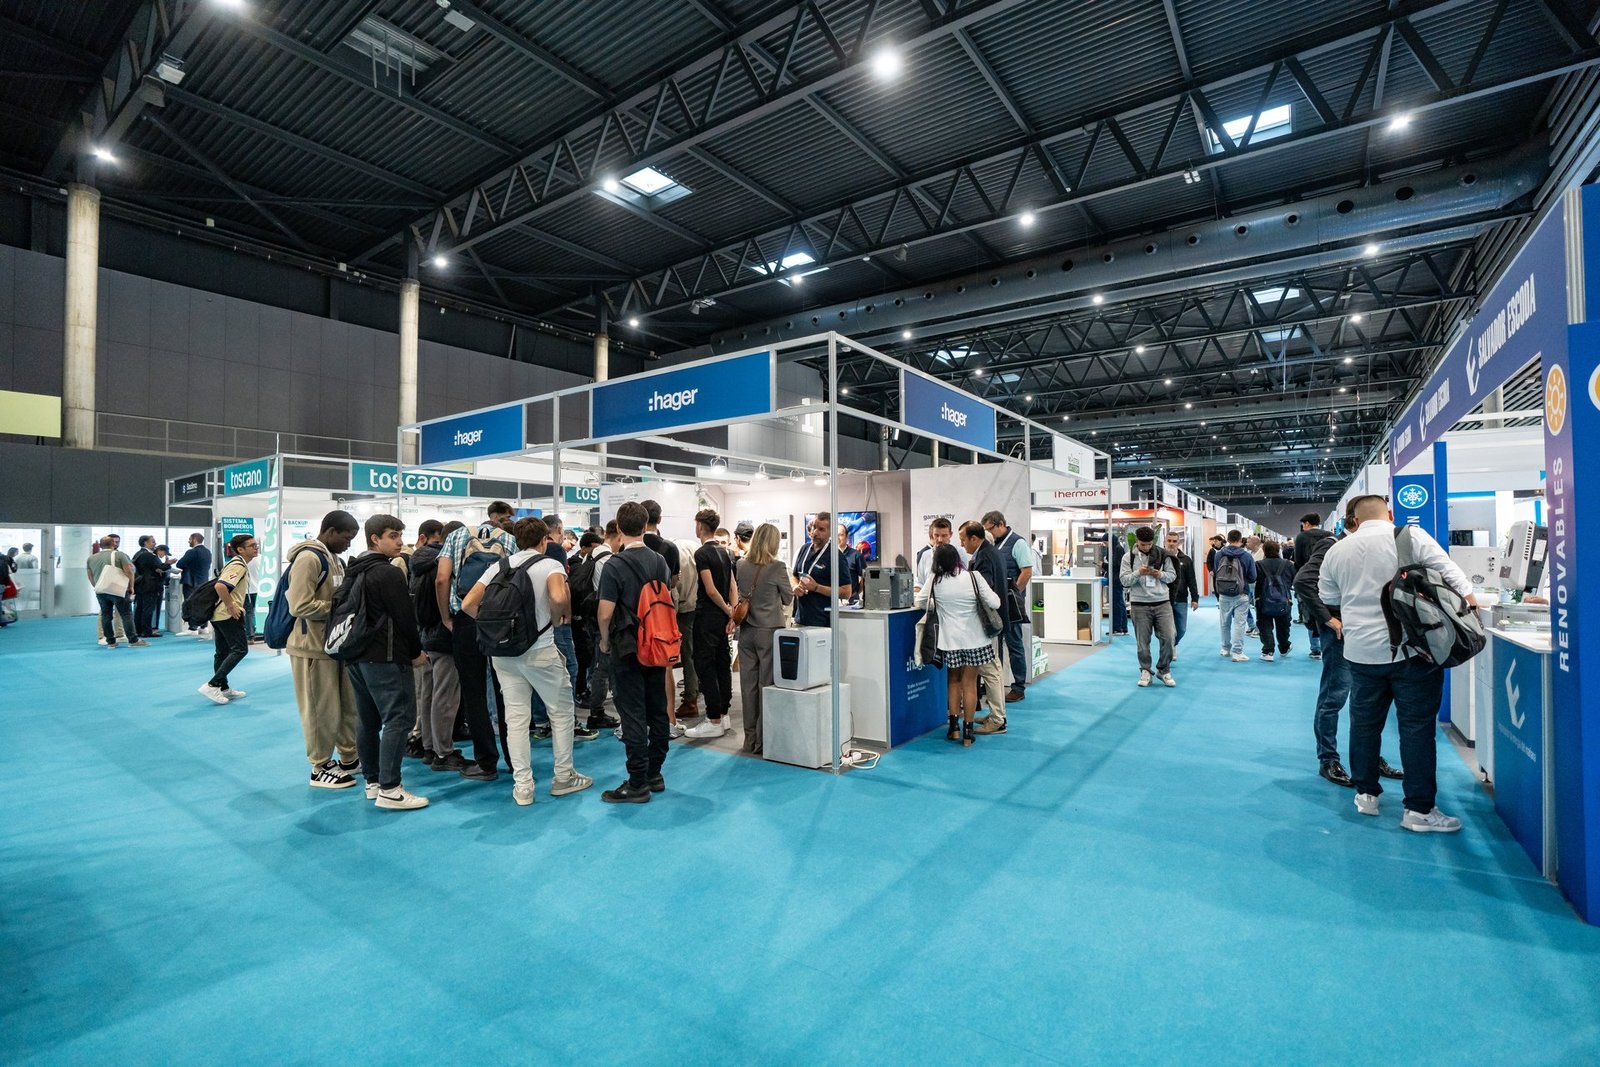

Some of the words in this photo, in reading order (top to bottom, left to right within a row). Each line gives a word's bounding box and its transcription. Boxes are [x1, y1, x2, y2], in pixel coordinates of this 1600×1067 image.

[1478, 308, 1506, 370] SALVADOR
[1506, 272, 1536, 338] ESCODA
[230, 469, 262, 489] toscano
[369, 468, 453, 492] toscano
[1552, 456, 1570, 673] RENOVABLES
